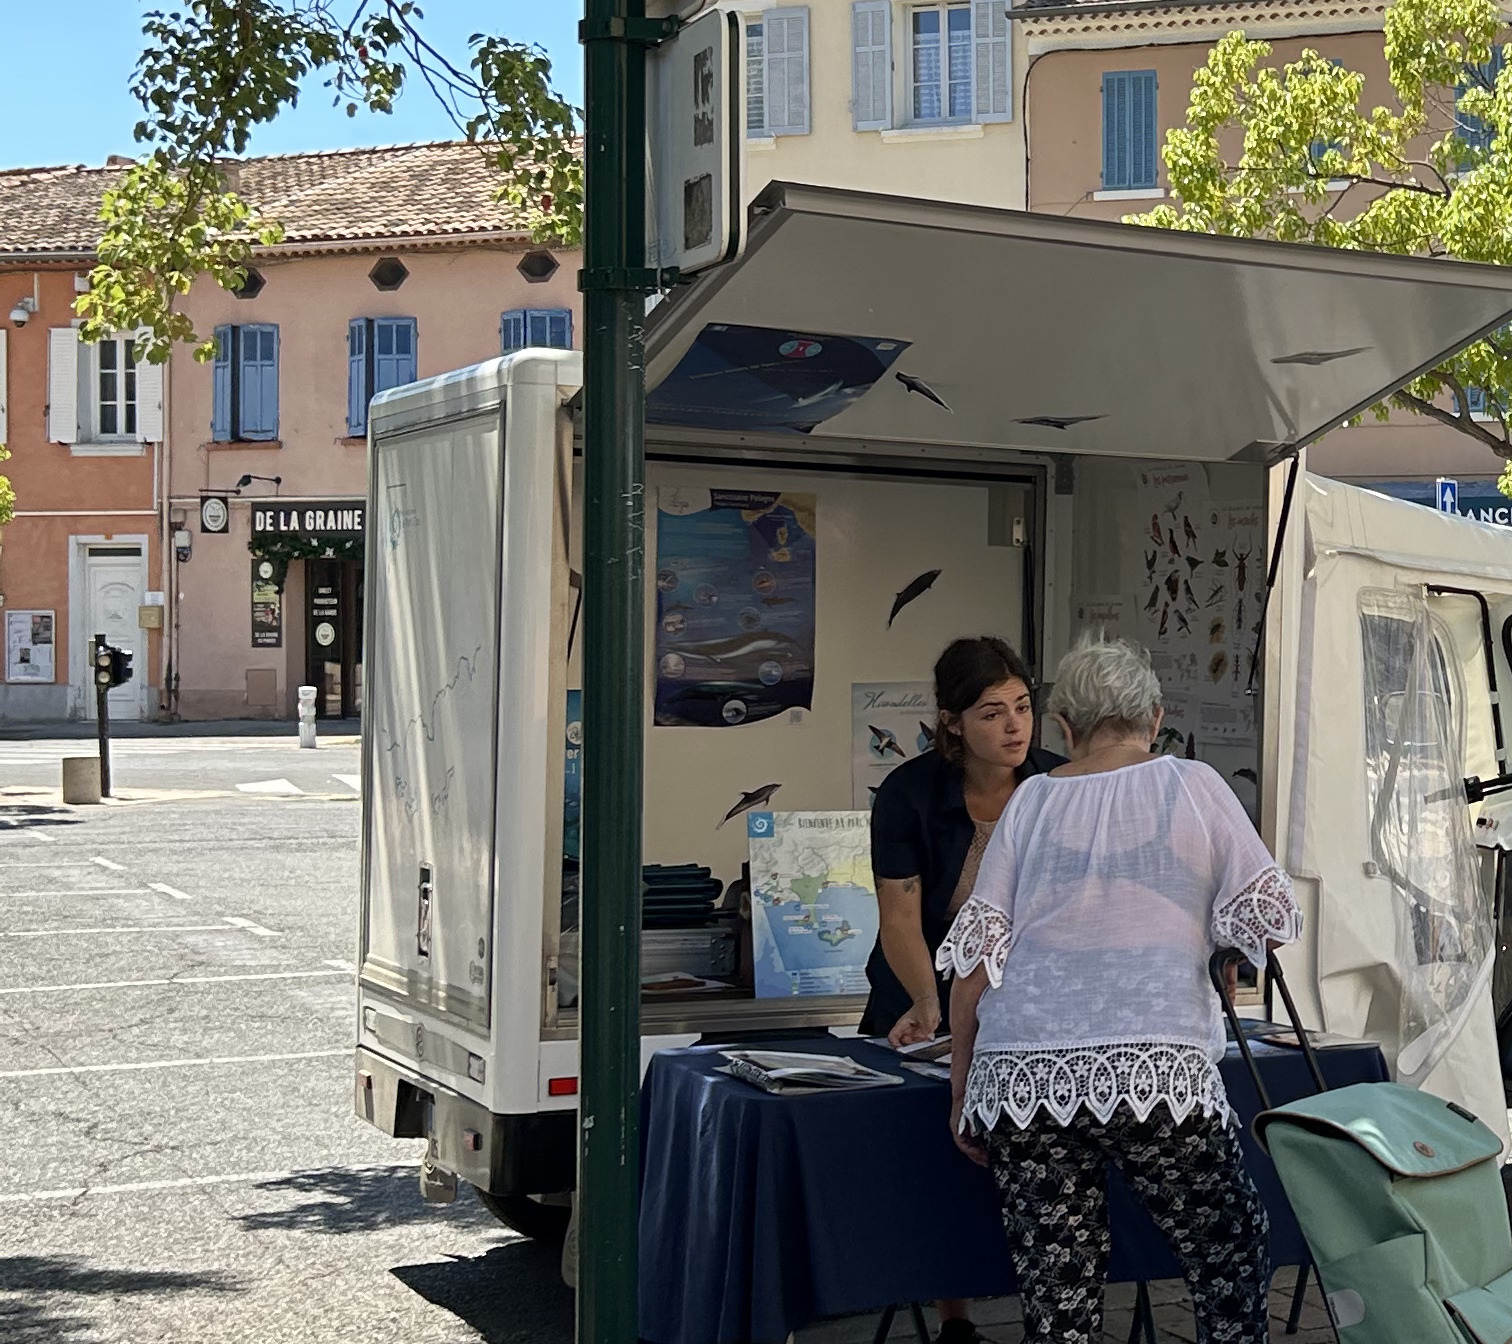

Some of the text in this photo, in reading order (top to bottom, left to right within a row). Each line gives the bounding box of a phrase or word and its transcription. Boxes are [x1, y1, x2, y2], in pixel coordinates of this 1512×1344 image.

[255, 510, 363, 531] DE LA GRAINE
